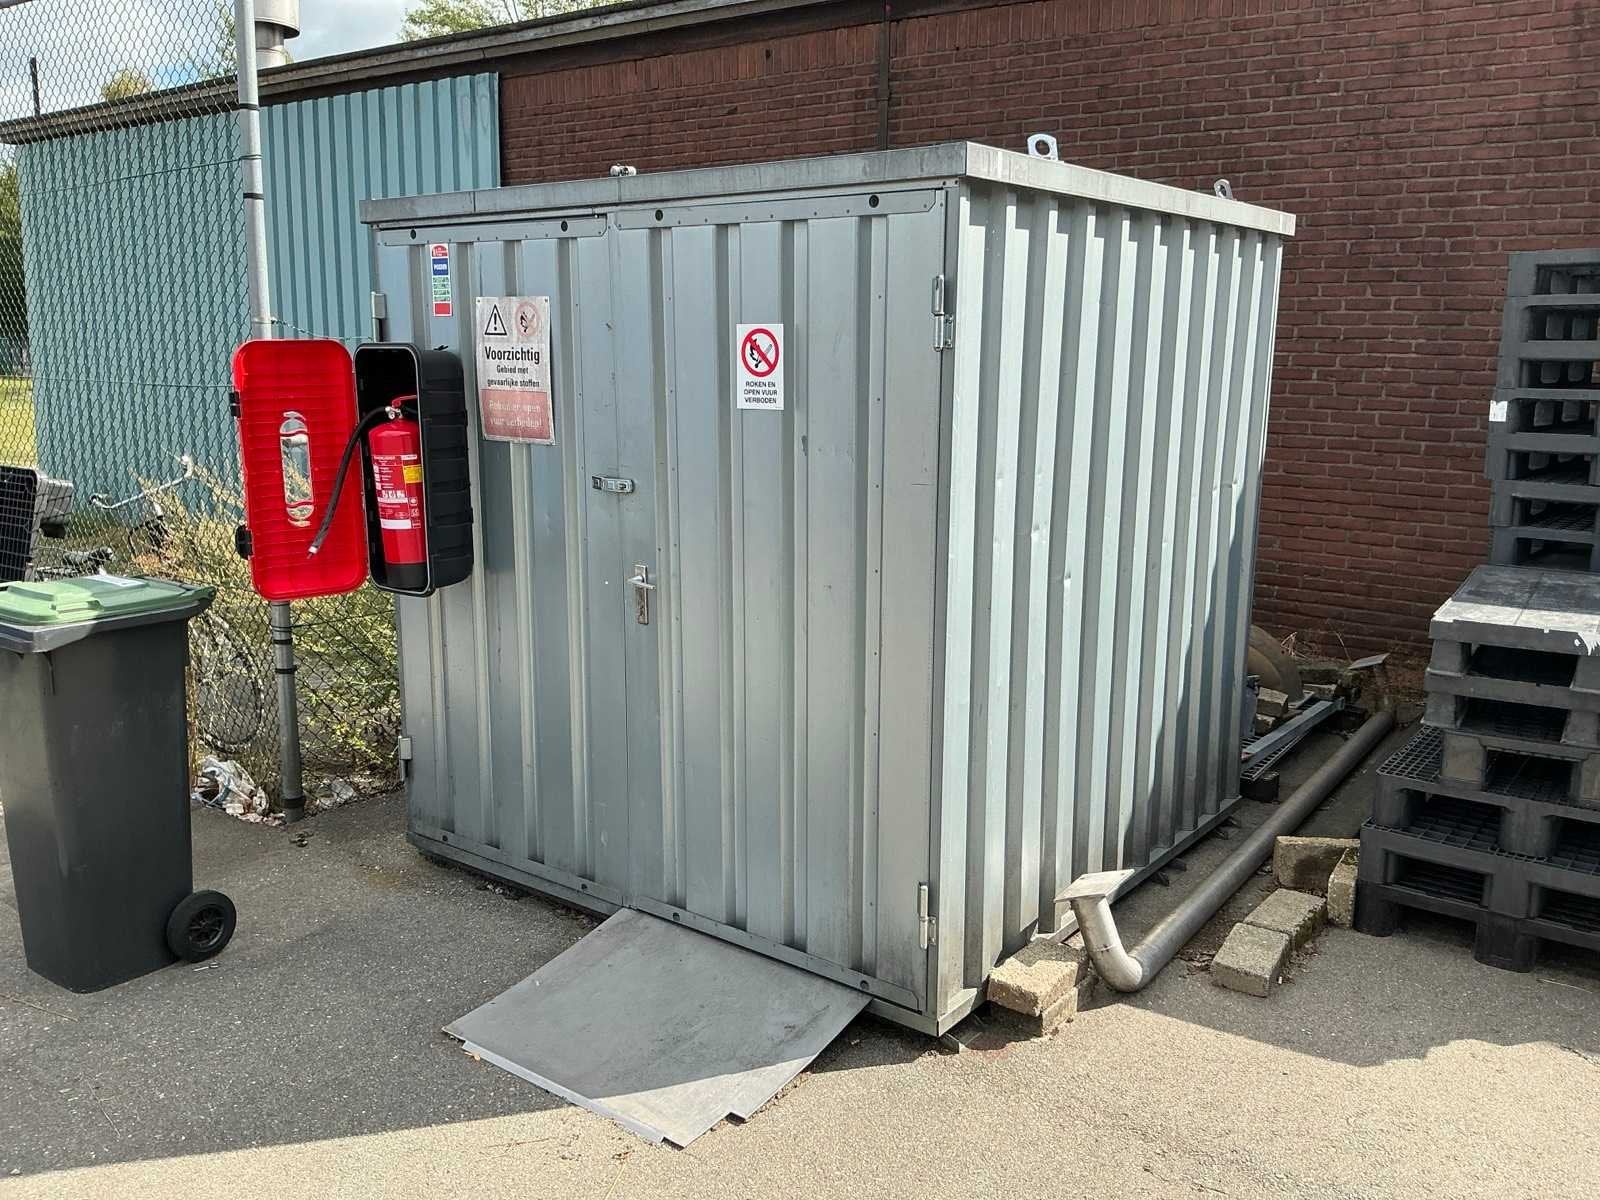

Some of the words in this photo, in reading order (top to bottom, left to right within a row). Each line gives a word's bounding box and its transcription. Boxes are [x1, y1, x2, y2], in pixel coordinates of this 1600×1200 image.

[485, 346, 540, 364] Voorzichtig
[496, 365, 516, 374] Gebied
[517, 366, 529, 374] met
[487, 378, 518, 388] gevaarlijke
[519, 379, 540, 388] stoffen
